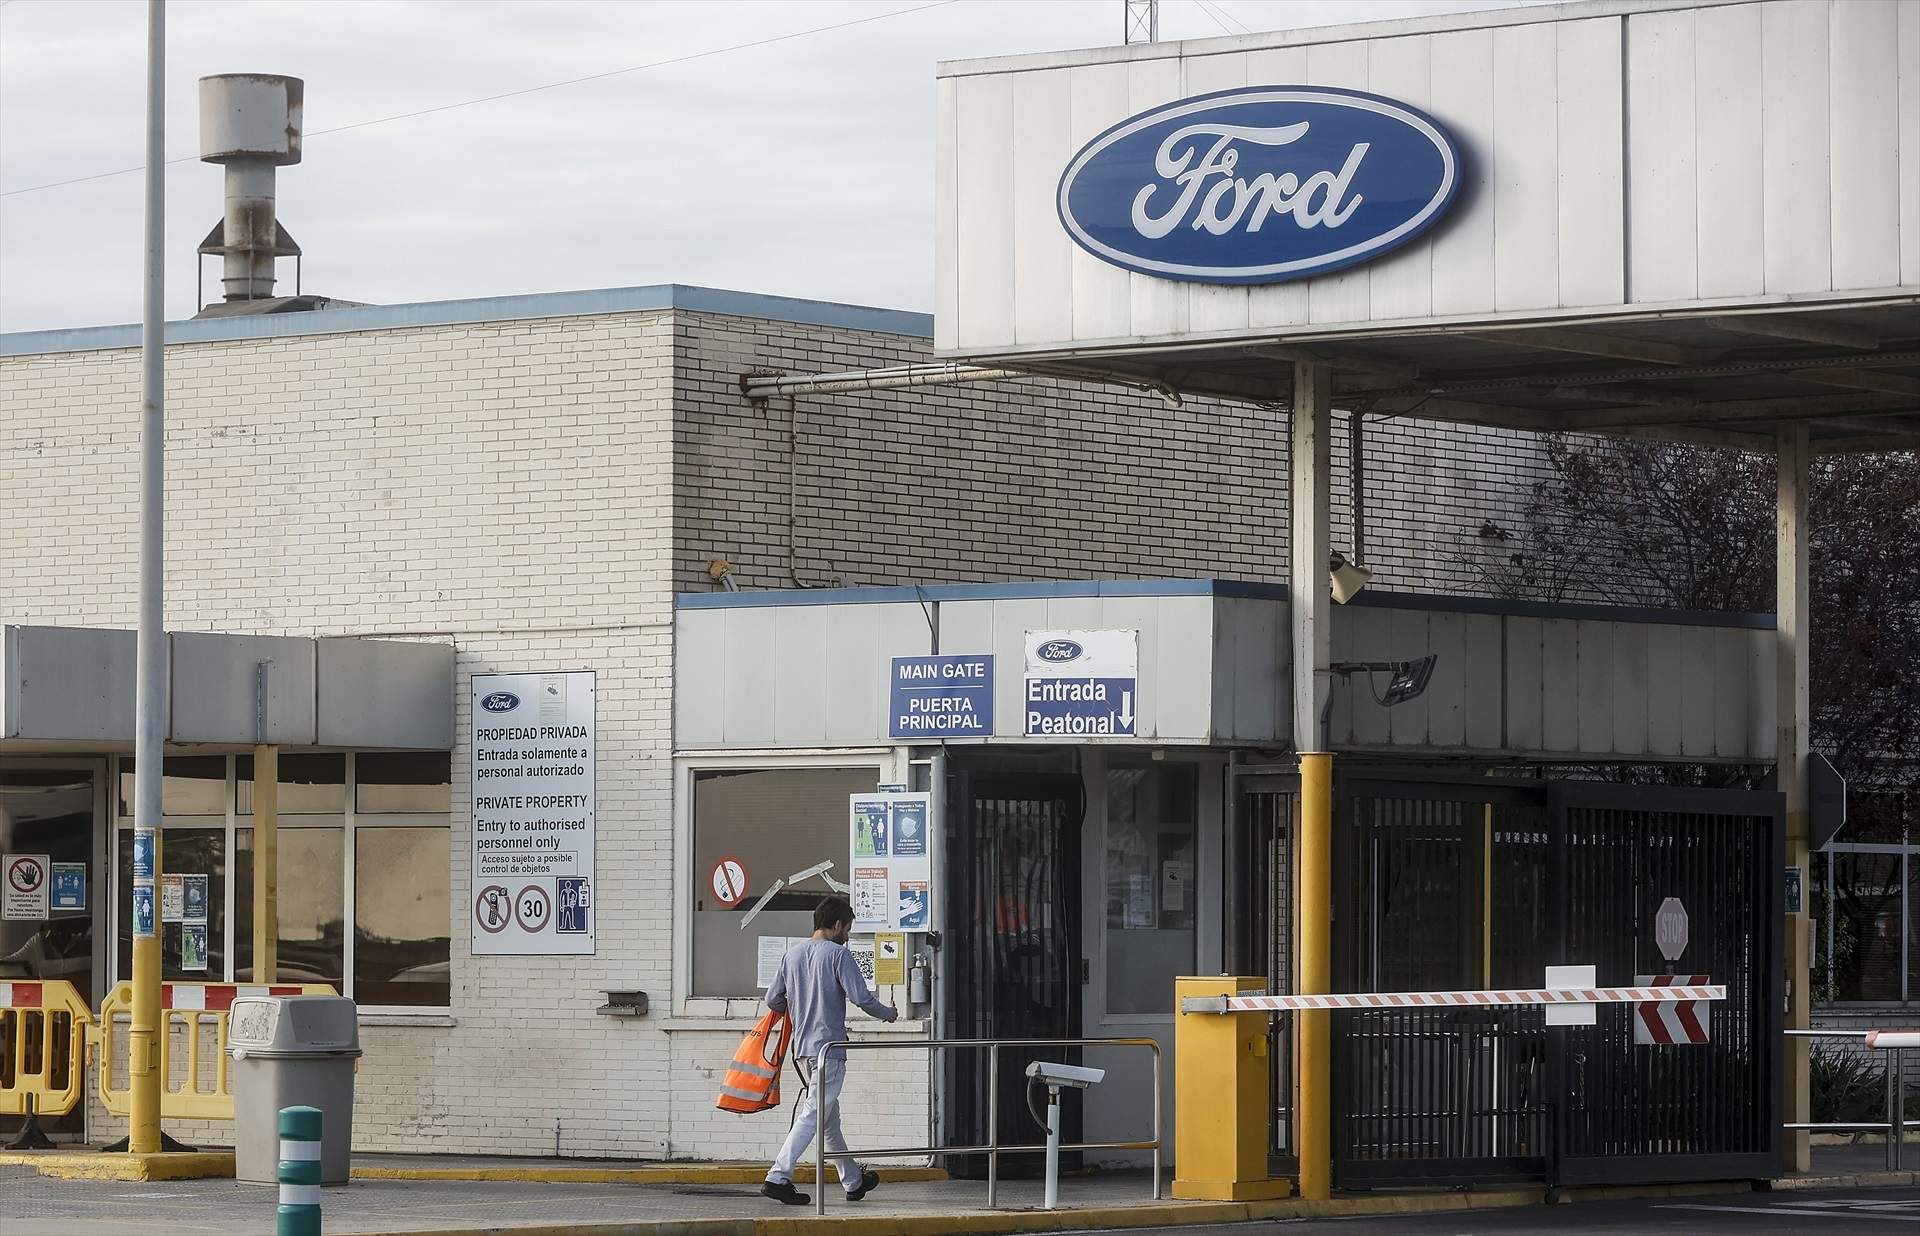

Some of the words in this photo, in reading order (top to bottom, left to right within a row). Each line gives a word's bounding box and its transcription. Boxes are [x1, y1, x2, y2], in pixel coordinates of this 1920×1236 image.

[1131, 121, 1370, 239] Ford
[1045, 643, 1073, 658] Ford
[900, 664, 938, 679] MAIN
[942, 663, 985, 678] GATE
[1028, 679, 1106, 701] Entrada
[488, 695, 512, 709] Ford
[910, 697, 973, 712] PUERTA
[899, 714, 983, 730] PRINCIPAL
[1028, 711, 1115, 734] Peatonal
[477, 727, 537, 741] PROPIEDAD
[540, 726, 588, 739] PRIVADA
[477, 748, 519, 761] Entrada
[521, 747, 578, 760] solamente
[580, 748, 588, 759] a
[477, 764, 523, 781] personal
[526, 763, 585, 777] autorizado
[476, 797, 523, 809] PRIVATE
[526, 795, 588, 808] PROPERTY
[477, 819, 507, 835] Entry
[509, 819, 521, 832] to
[524, 818, 586, 831] authorised
[477, 836, 533, 852] personnel
[535, 835, 561, 851] only
[481, 854, 510, 864] Acceso
[511, 854, 536, 865] sujeto
[543, 853, 573, 864] posible
[481, 864, 509, 873] control
[510, 864, 520, 873] de
[521, 863, 551, 875] objetos
[523, 899, 543, 918] 30
[1661, 912, 1684, 944] STOP
